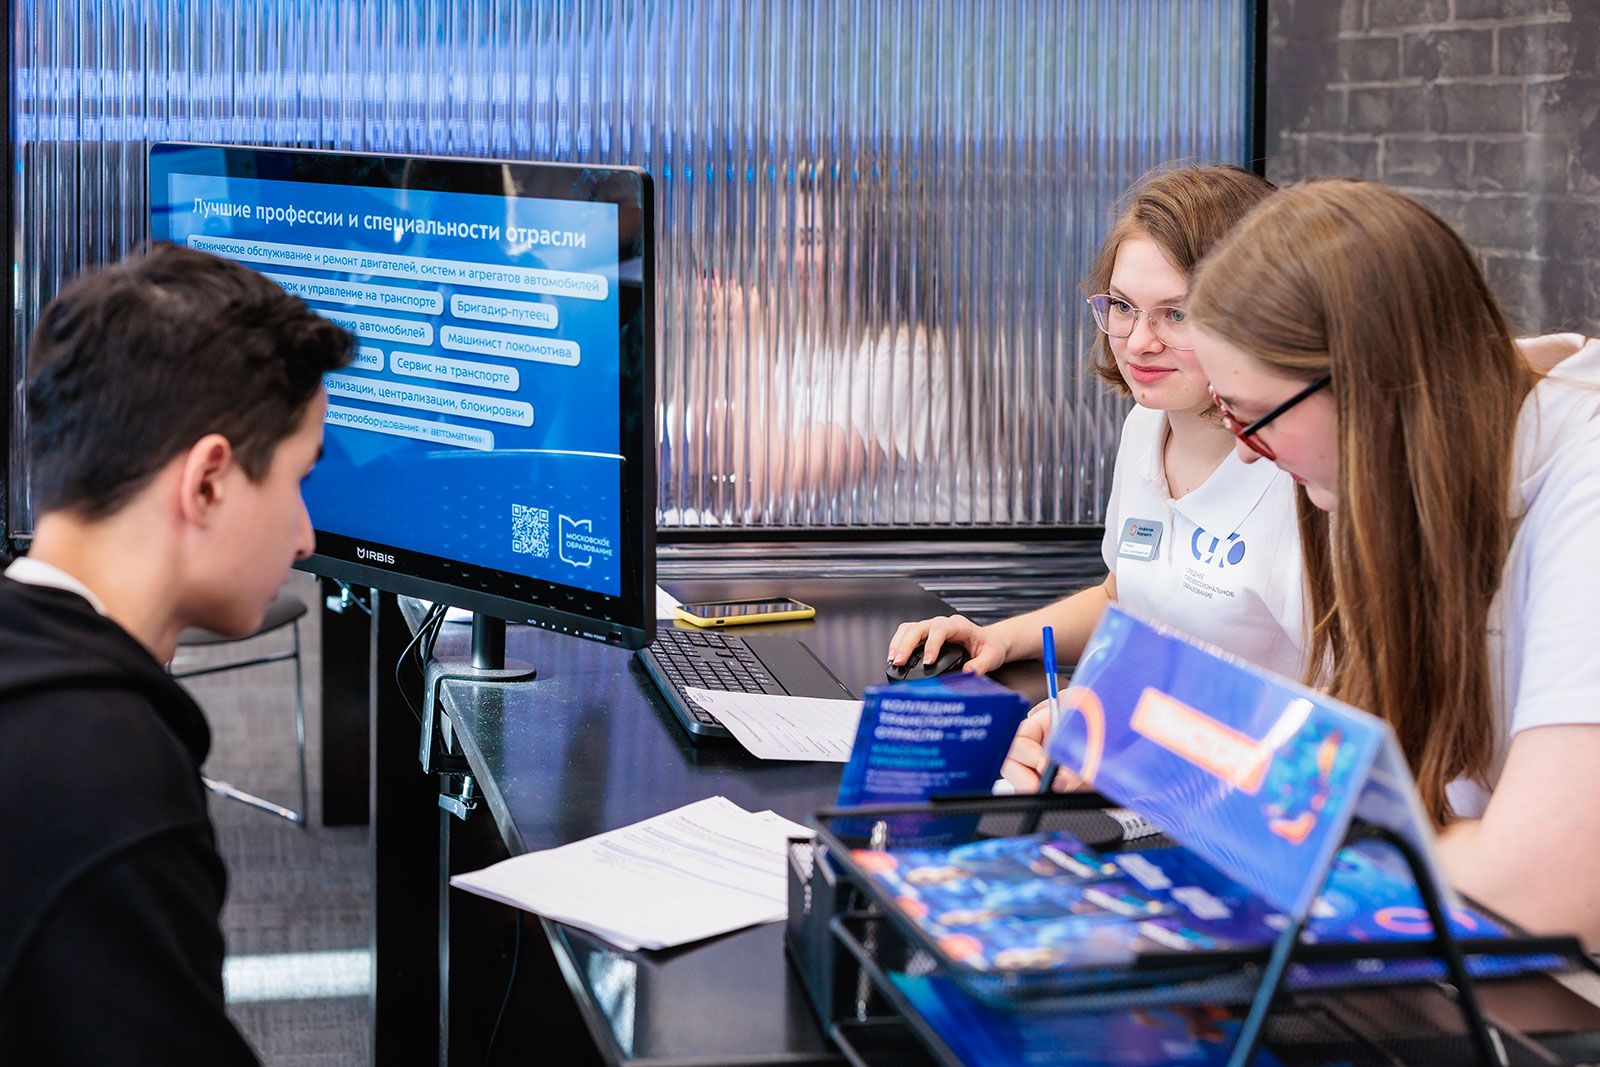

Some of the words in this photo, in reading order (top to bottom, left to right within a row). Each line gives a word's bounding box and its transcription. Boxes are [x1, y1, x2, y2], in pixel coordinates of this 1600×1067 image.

[193, 198, 251, 218] Лучшие
[256, 204, 343, 227] профессии
[349, 213, 358, 228] и
[363, 214, 499, 241] специальности
[506, 226, 587, 249] отрасли
[193, 239, 244, 254] Техническое
[247, 244, 312, 263] обслуживание
[314, 253, 321, 262] и
[323, 254, 358, 266] ремонт
[361, 257, 418, 274] двигателей,
[421, 264, 456, 277] систем
[459, 268, 466, 278] и
[468, 269, 521, 285] агрегатов
[523, 274, 600, 292] автомобилей
[273, 280, 298, 291] озок
[300, 284, 306, 292] и
[308, 285, 363, 299] управление
[366, 292, 377, 300] на
[380, 293, 436, 308] транспорте
[457, 300, 550, 322] Бригадир-путеец
[329, 319, 357, 329] анию
[360, 321, 425, 338] автомобилей
[448, 333, 502, 348] Машинист
[505, 341, 572, 358] локомотива
[355, 353, 378, 364] тике
[397, 357, 432, 372] Сервис
[435, 364, 447, 375] на
[450, 365, 510, 384] транспорте
[323, 380, 376, 396] нализации,
[378, 388, 458, 409] централизации,
[460, 398, 525, 419] блокировки
[566, 533, 610, 547] МОСКОВСКОЕ
[566, 541, 613, 556] ОБРАЗОВАНИЕ
[366, 550, 395, 564] IRBIS
